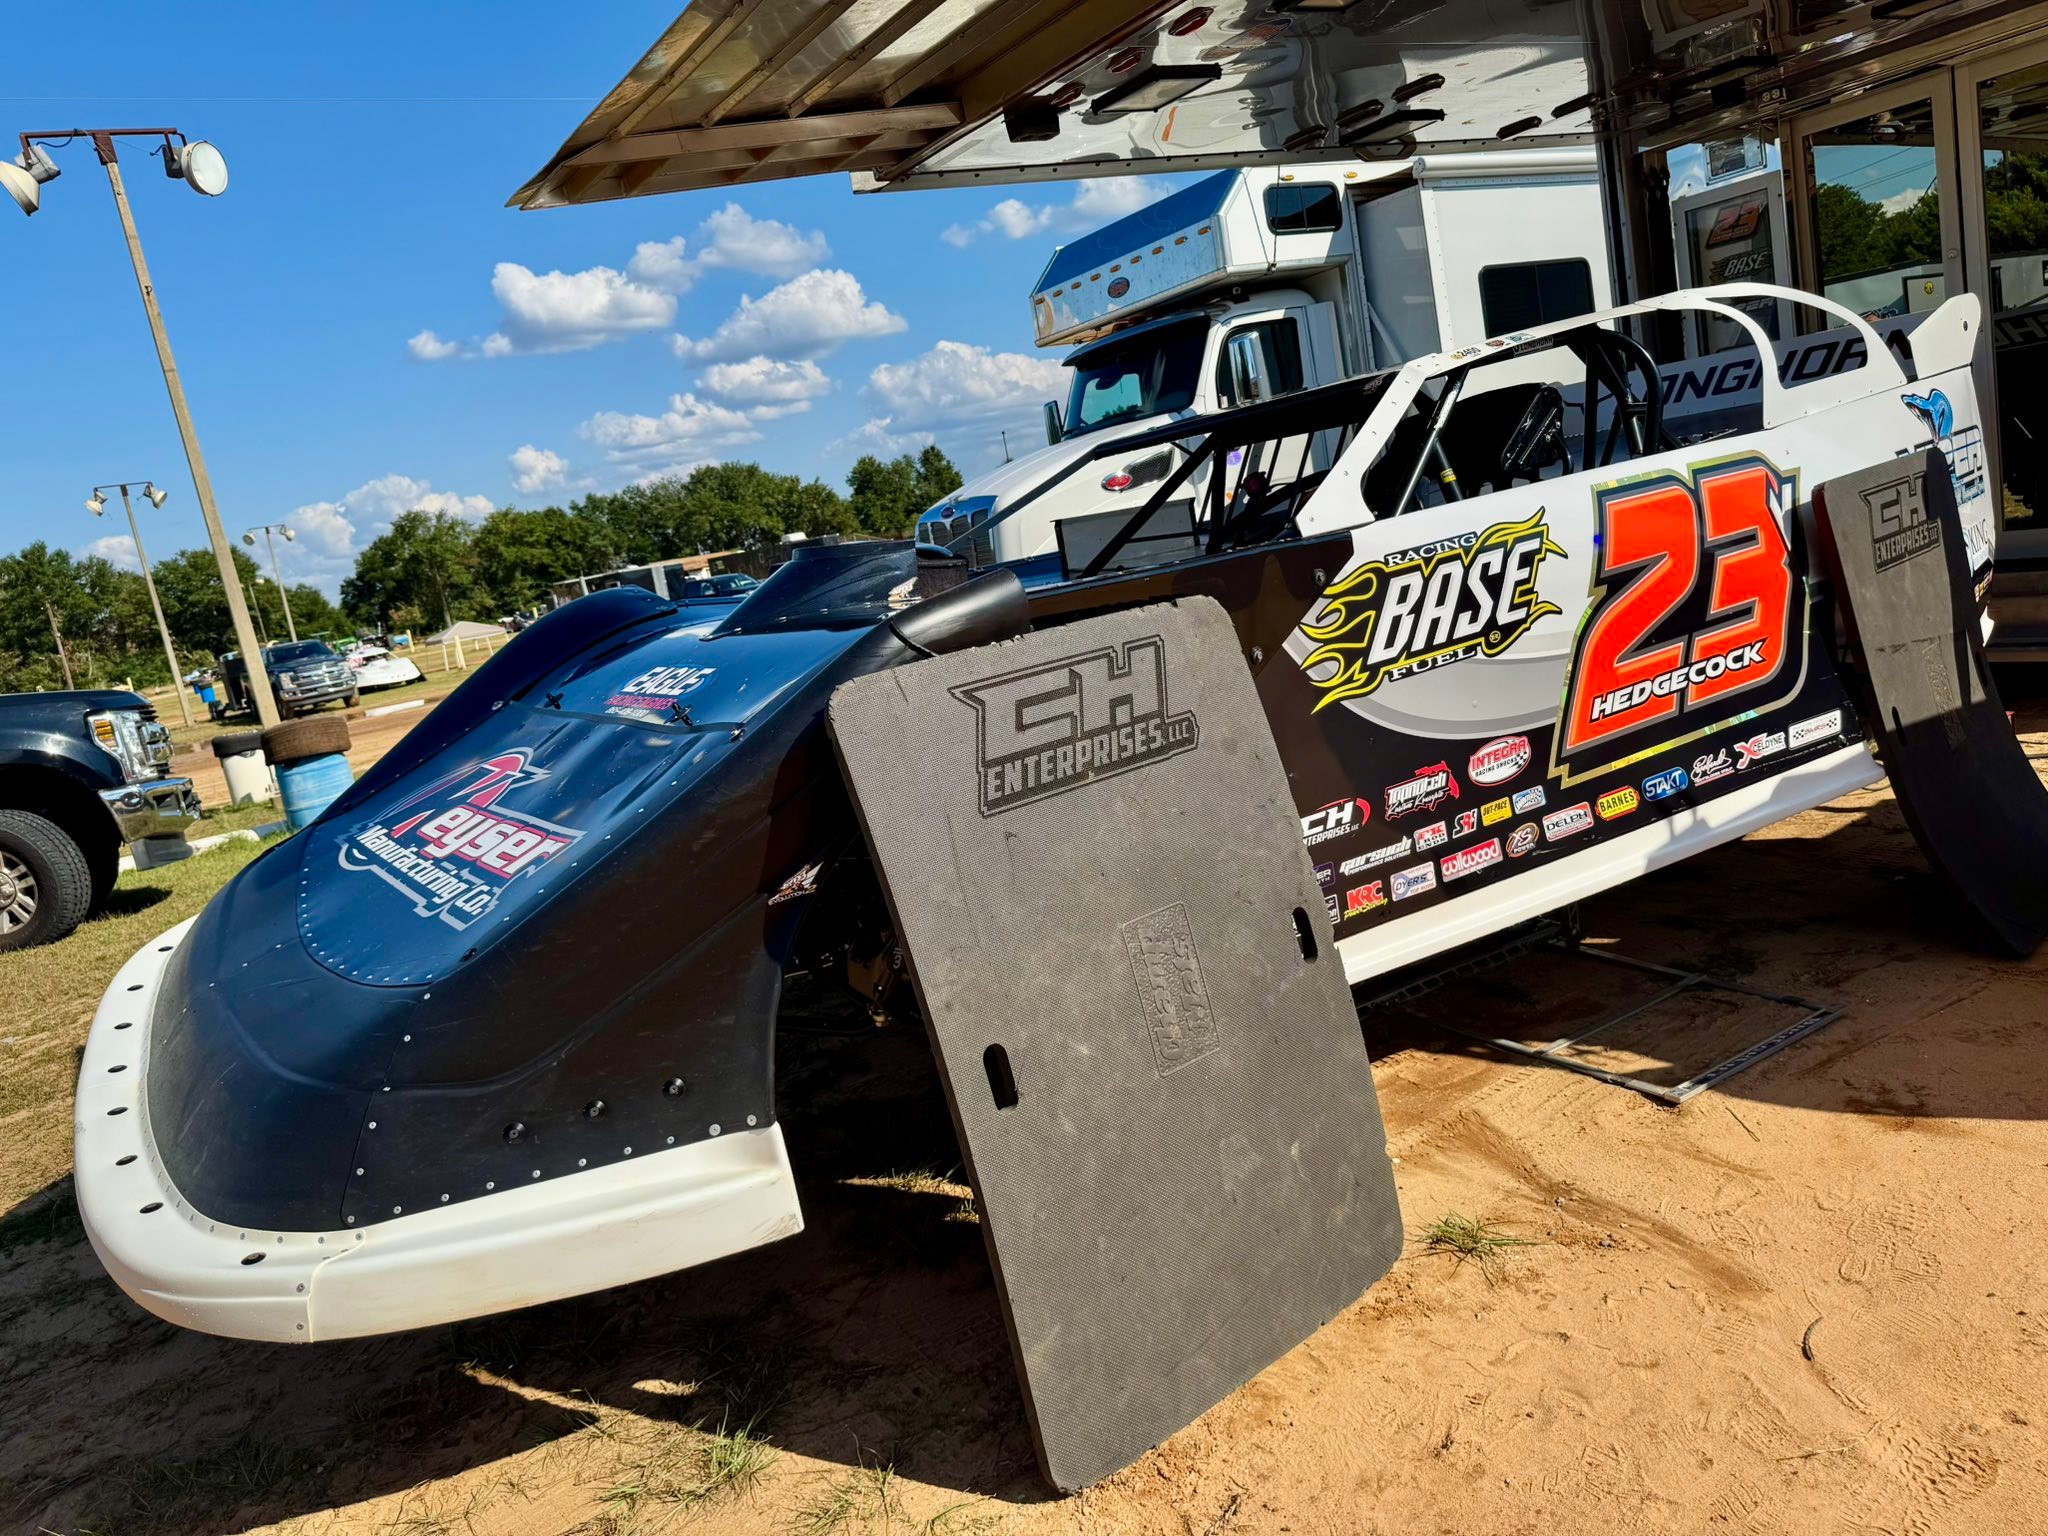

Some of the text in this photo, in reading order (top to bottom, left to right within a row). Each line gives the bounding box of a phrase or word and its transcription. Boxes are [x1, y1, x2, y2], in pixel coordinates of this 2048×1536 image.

[1724, 252, 1768, 277] BASE
[1386, 533, 1478, 567] RACING
[1367, 538, 1541, 665] BASE
[1567, 466, 1790, 750] 23
[1390, 645, 1476, 681] FUEL
[1591, 641, 1764, 720] HEDGECOCK
[1169, 720, 1190, 742] LLC
[1471, 739, 1526, 772] INTEGRA
[1647, 771, 1683, 798] STAKT
[1483, 799, 1508, 816] OUT-PACE
[1600, 790, 1635, 813] BARNES
[1300, 801, 1353, 838] CH
[1546, 811, 1588, 831] DELPH
[1418, 838, 1446, 851] ENDS
[1424, 833, 1445, 844] ROD
[1508, 827, 1532, 851] XS
[355, 825, 496, 915] Manufacturing Co.
[1442, 839, 1500, 876] wilwood
[1347, 880, 1383, 911] KRC
[1396, 873, 1426, 892] DYERS
